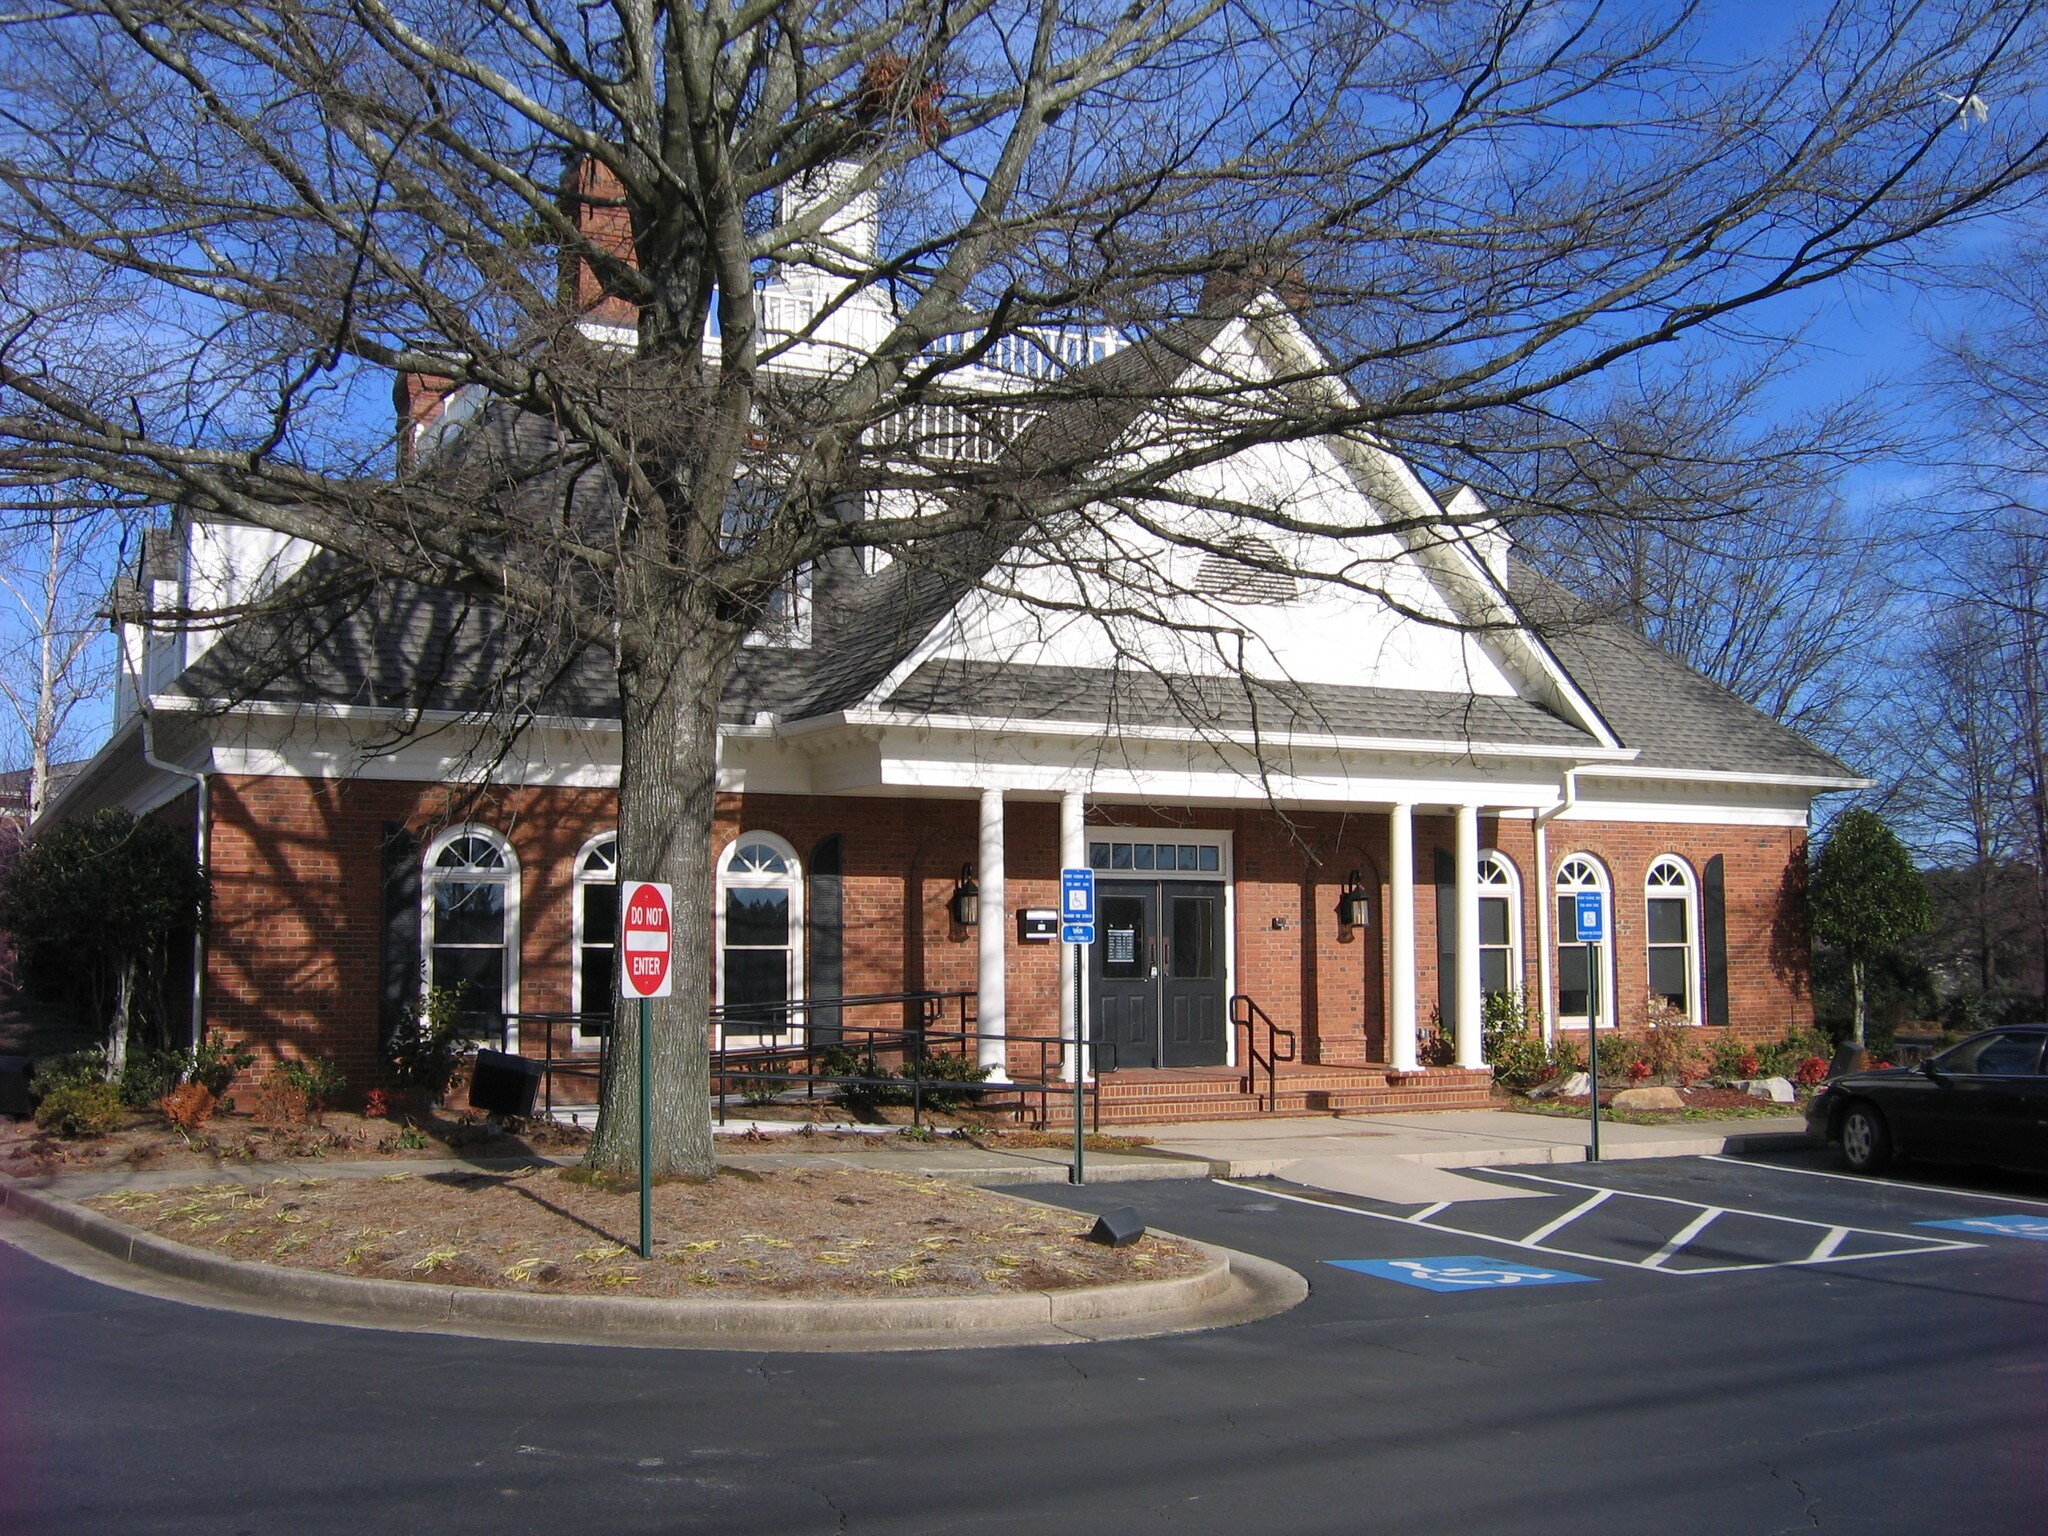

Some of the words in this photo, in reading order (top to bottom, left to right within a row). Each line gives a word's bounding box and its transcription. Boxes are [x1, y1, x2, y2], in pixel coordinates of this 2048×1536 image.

[631, 906, 643, 925] DO
[646, 907, 663, 926] NOT
[633, 957, 660, 975] ENTER
